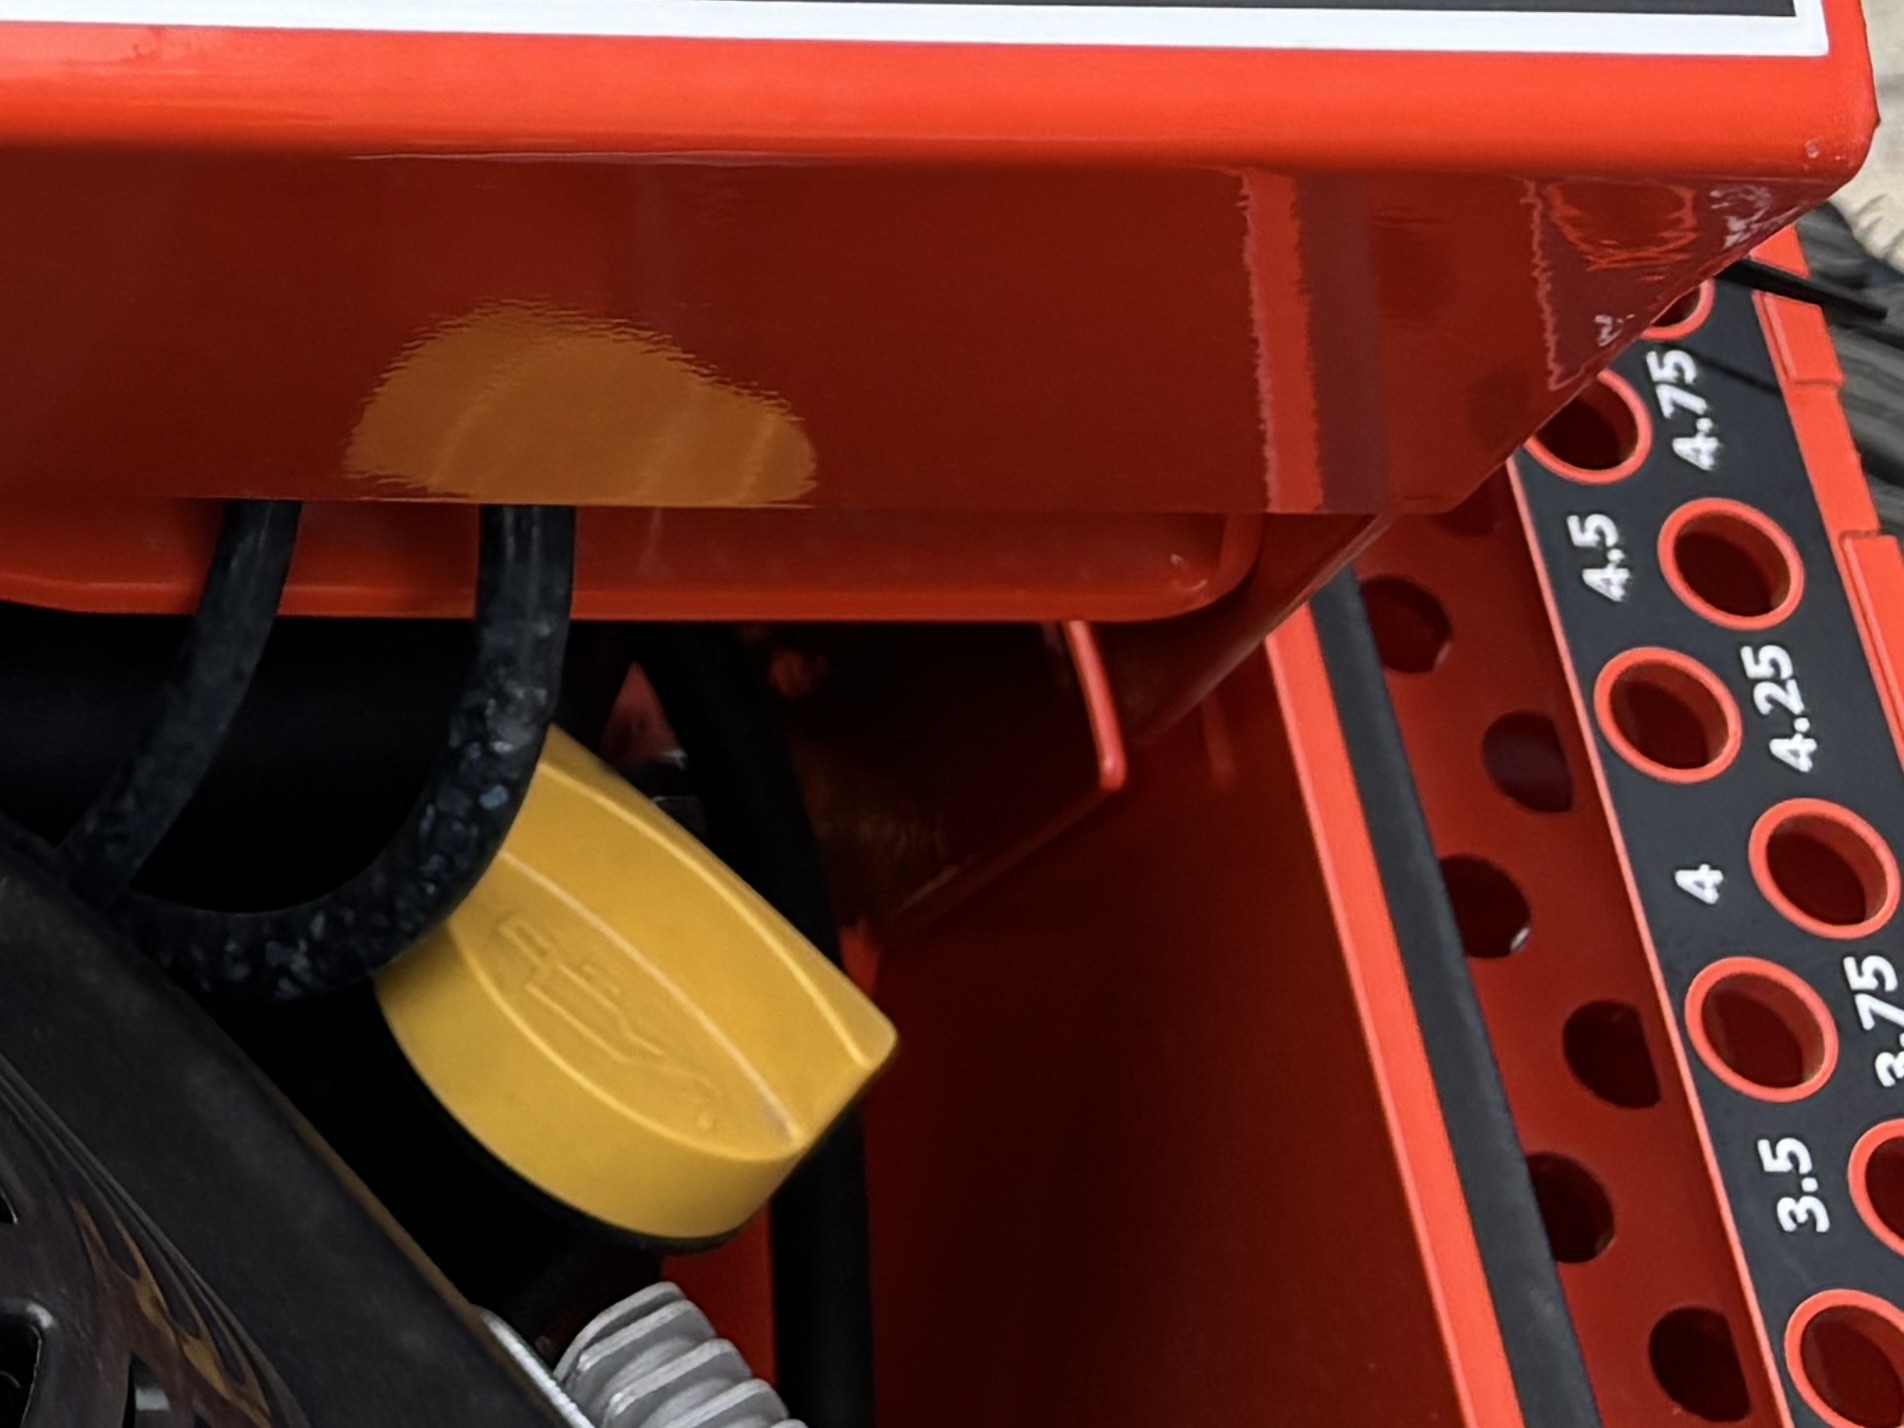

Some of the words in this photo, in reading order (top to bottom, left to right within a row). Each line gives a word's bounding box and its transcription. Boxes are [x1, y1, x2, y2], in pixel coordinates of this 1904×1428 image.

[1647, 347, 1718, 473] 4.75
[1567, 513, 1633, 602] 4.5
[1740, 642, 1820, 774] 4.25
[1674, 862, 1726, 906] 4
[1757, 1136, 1832, 1235] 3.5
